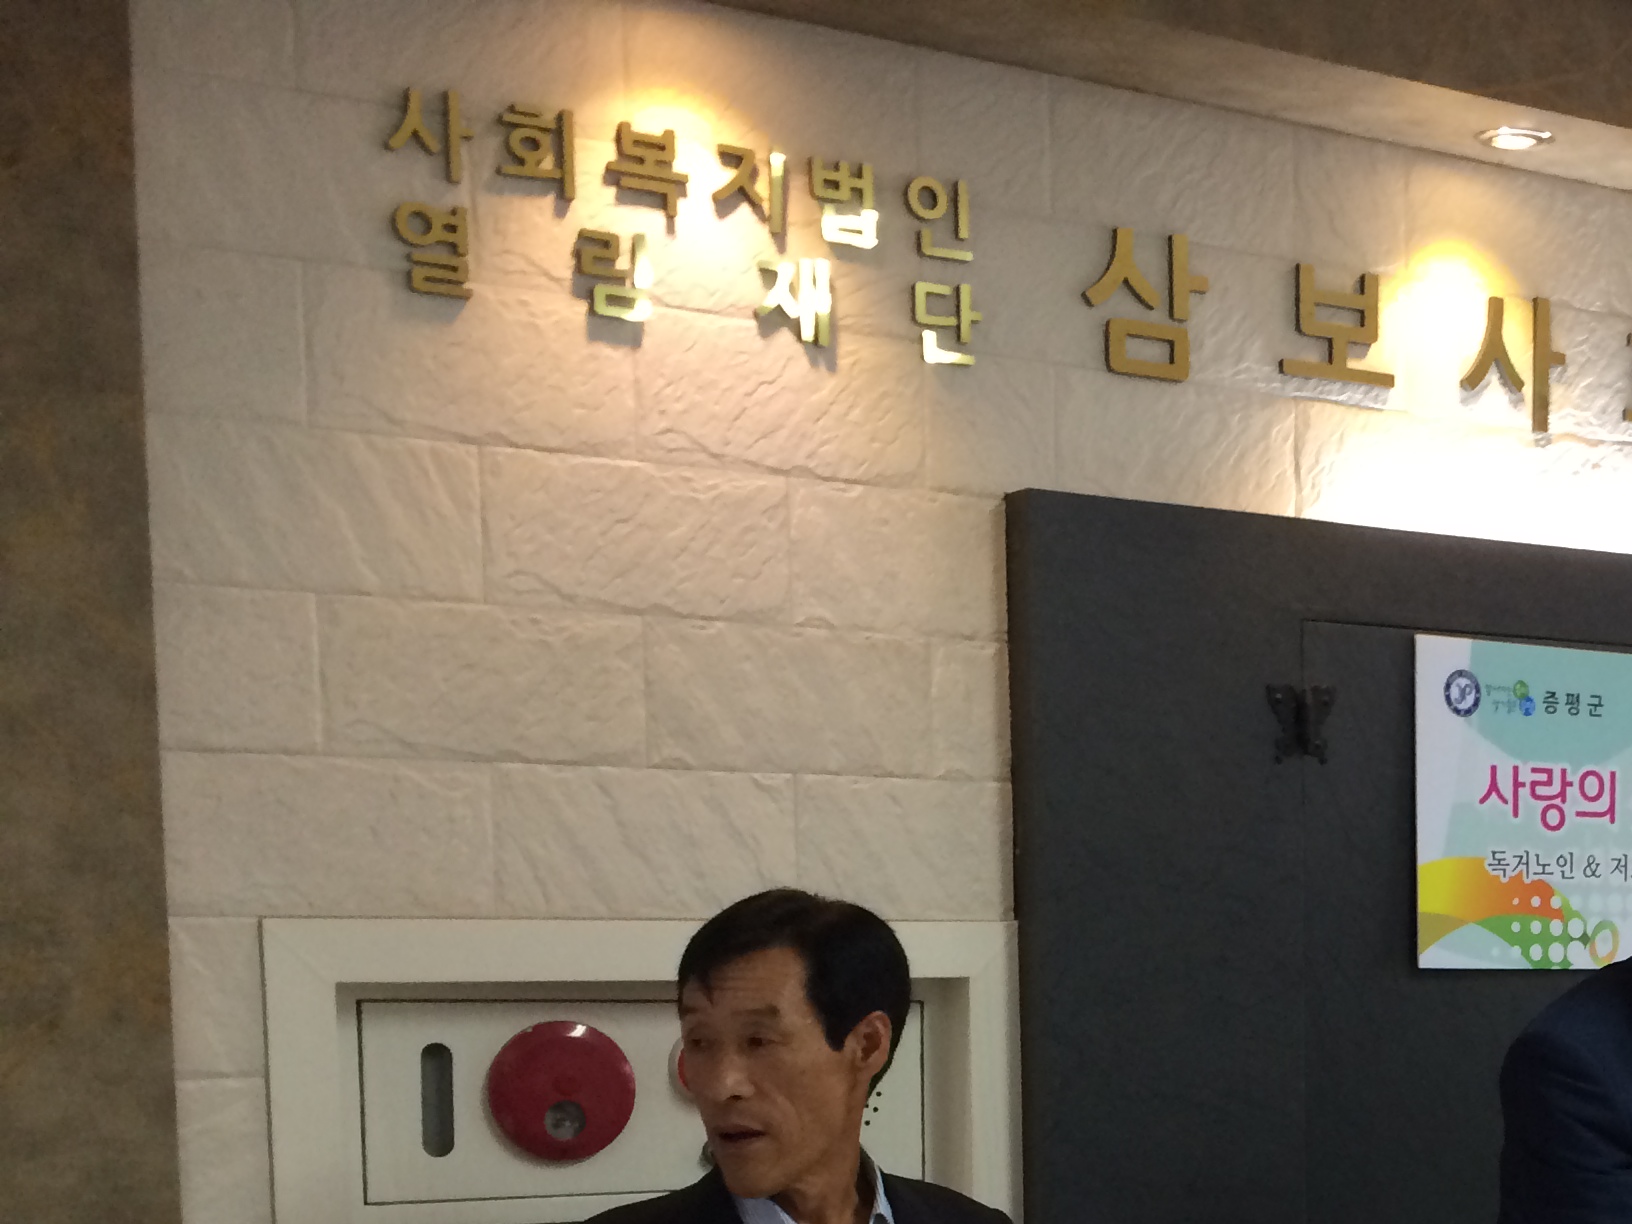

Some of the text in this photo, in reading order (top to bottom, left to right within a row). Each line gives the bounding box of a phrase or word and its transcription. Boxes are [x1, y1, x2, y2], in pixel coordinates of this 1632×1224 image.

[386, 87, 974, 262] 사회복지법인
[394, 201, 982, 366] 열림재단
[1542, 690, 1604, 717] 증평군
[1478, 764, 1616, 832] 사랑의
[1487, 849, 1575, 882] 독거노인
[1582, 854, 1602, 879] &
